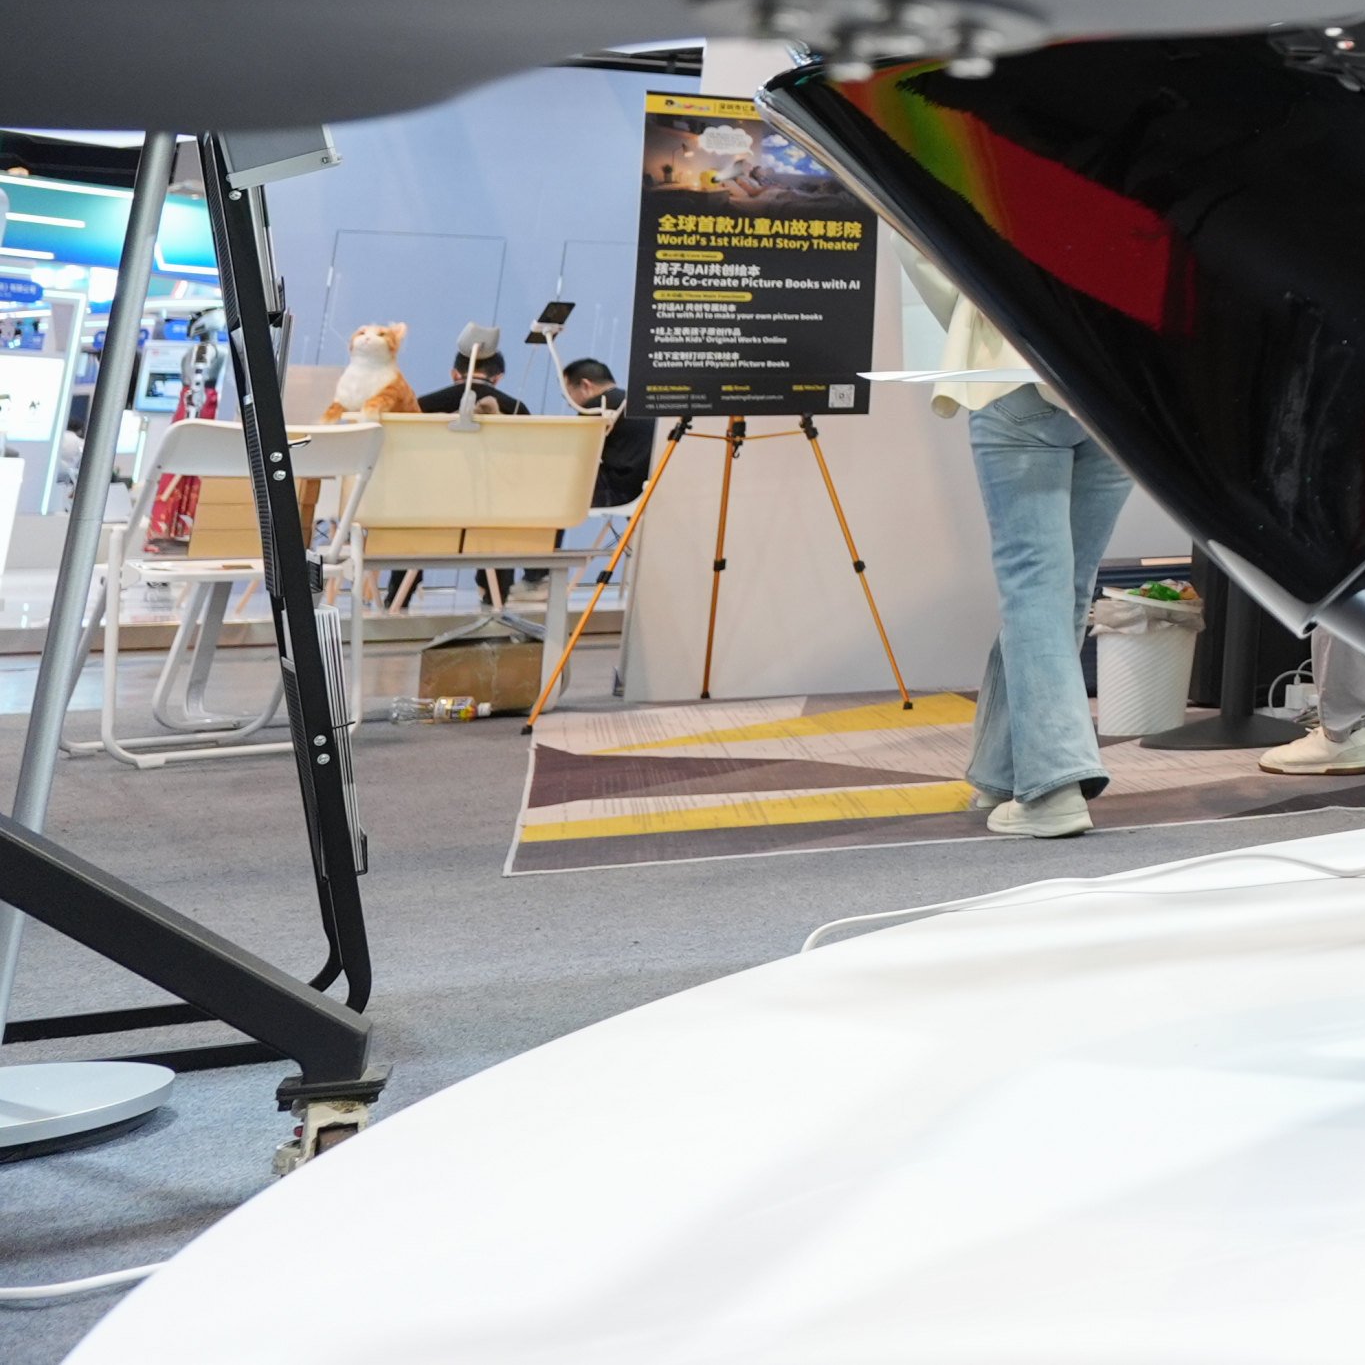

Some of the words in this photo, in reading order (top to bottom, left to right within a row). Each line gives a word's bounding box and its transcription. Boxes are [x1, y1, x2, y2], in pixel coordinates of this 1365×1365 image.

[658, 214, 862, 238] 全球首款儿童AI故事影院
[657, 233, 707, 246] World's
[710, 235, 729, 247] 1st
[731, 236, 759, 248] Kids
[760, 237, 773, 248] AI
[776, 238, 810, 252] Story
[811, 238, 860, 251] Theater
[655, 262, 761, 277] 孩子与AI共创绘本
[653, 275, 680, 286] Kids
[681, 276, 739, 287] Co-create
[741, 277, 783, 289] Picture
[785, 278, 820, 290] Books
[821, 279, 847, 290] with
[848, 280, 860, 290] AI
[772, 313, 800, 322] picture
[800, 313, 823, 321] books
[654, 335, 684, 343] Publish
[706, 336, 737, 345] Original
[652, 360, 683, 368] Custom
[684, 360, 704, 368] Print
[705, 360, 737, 369] Physical
[738, 360, 765, 368] Picture
